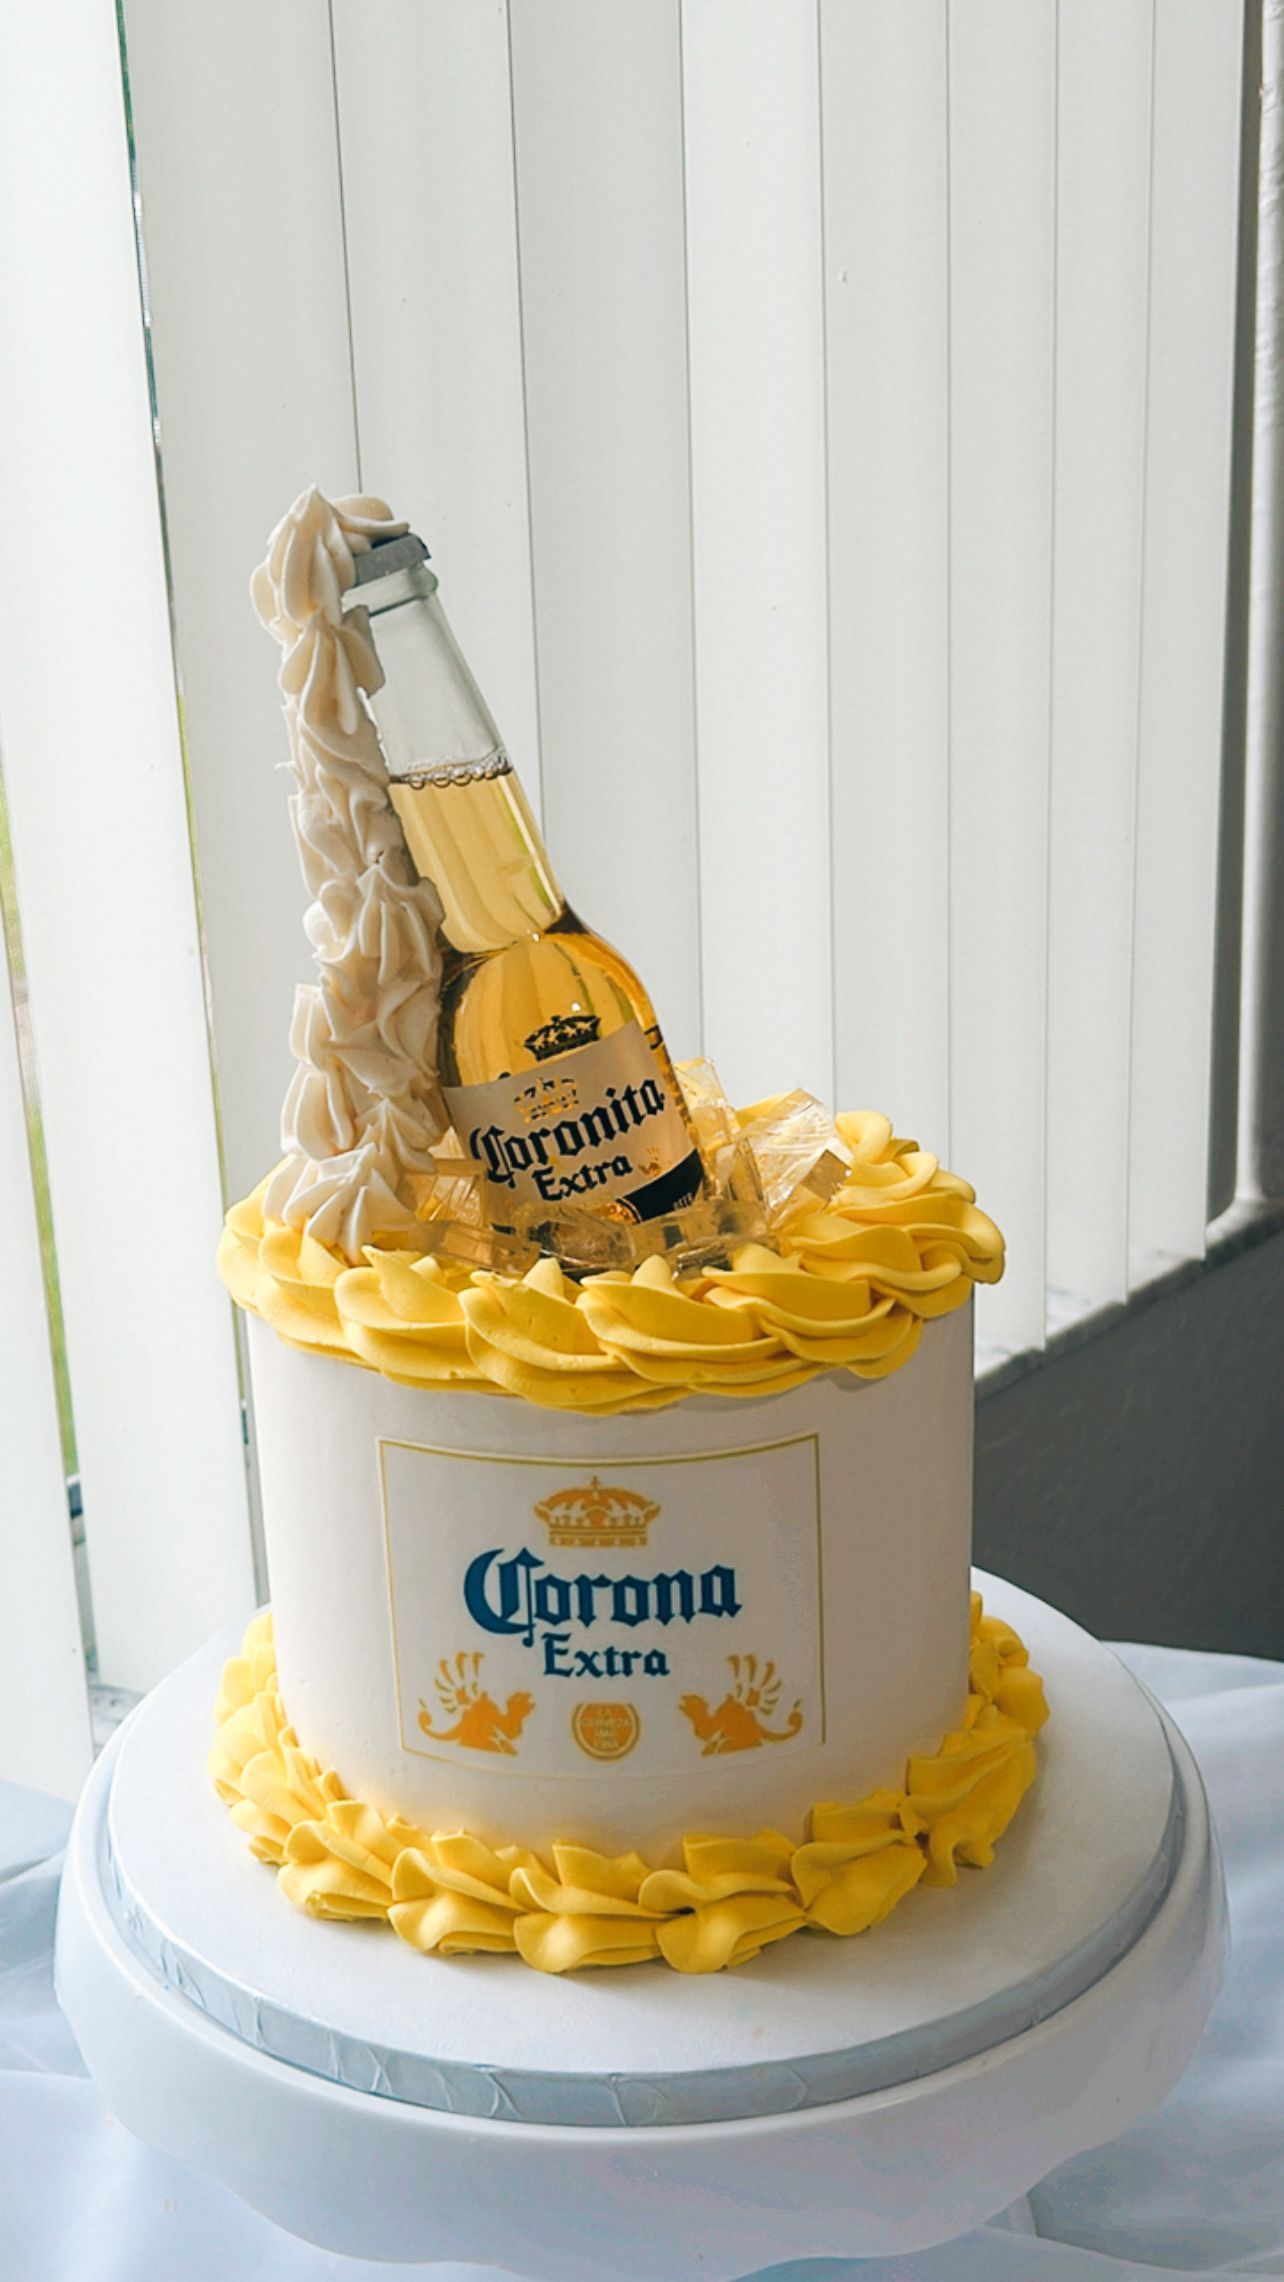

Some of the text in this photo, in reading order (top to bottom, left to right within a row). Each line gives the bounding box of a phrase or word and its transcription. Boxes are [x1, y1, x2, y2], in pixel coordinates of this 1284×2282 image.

[469, 1079, 665, 1188] Coronita
[531, 1155, 633, 1201] Extra
[463, 1547, 742, 1648] Corona
[541, 1632, 670, 1678] Extra
